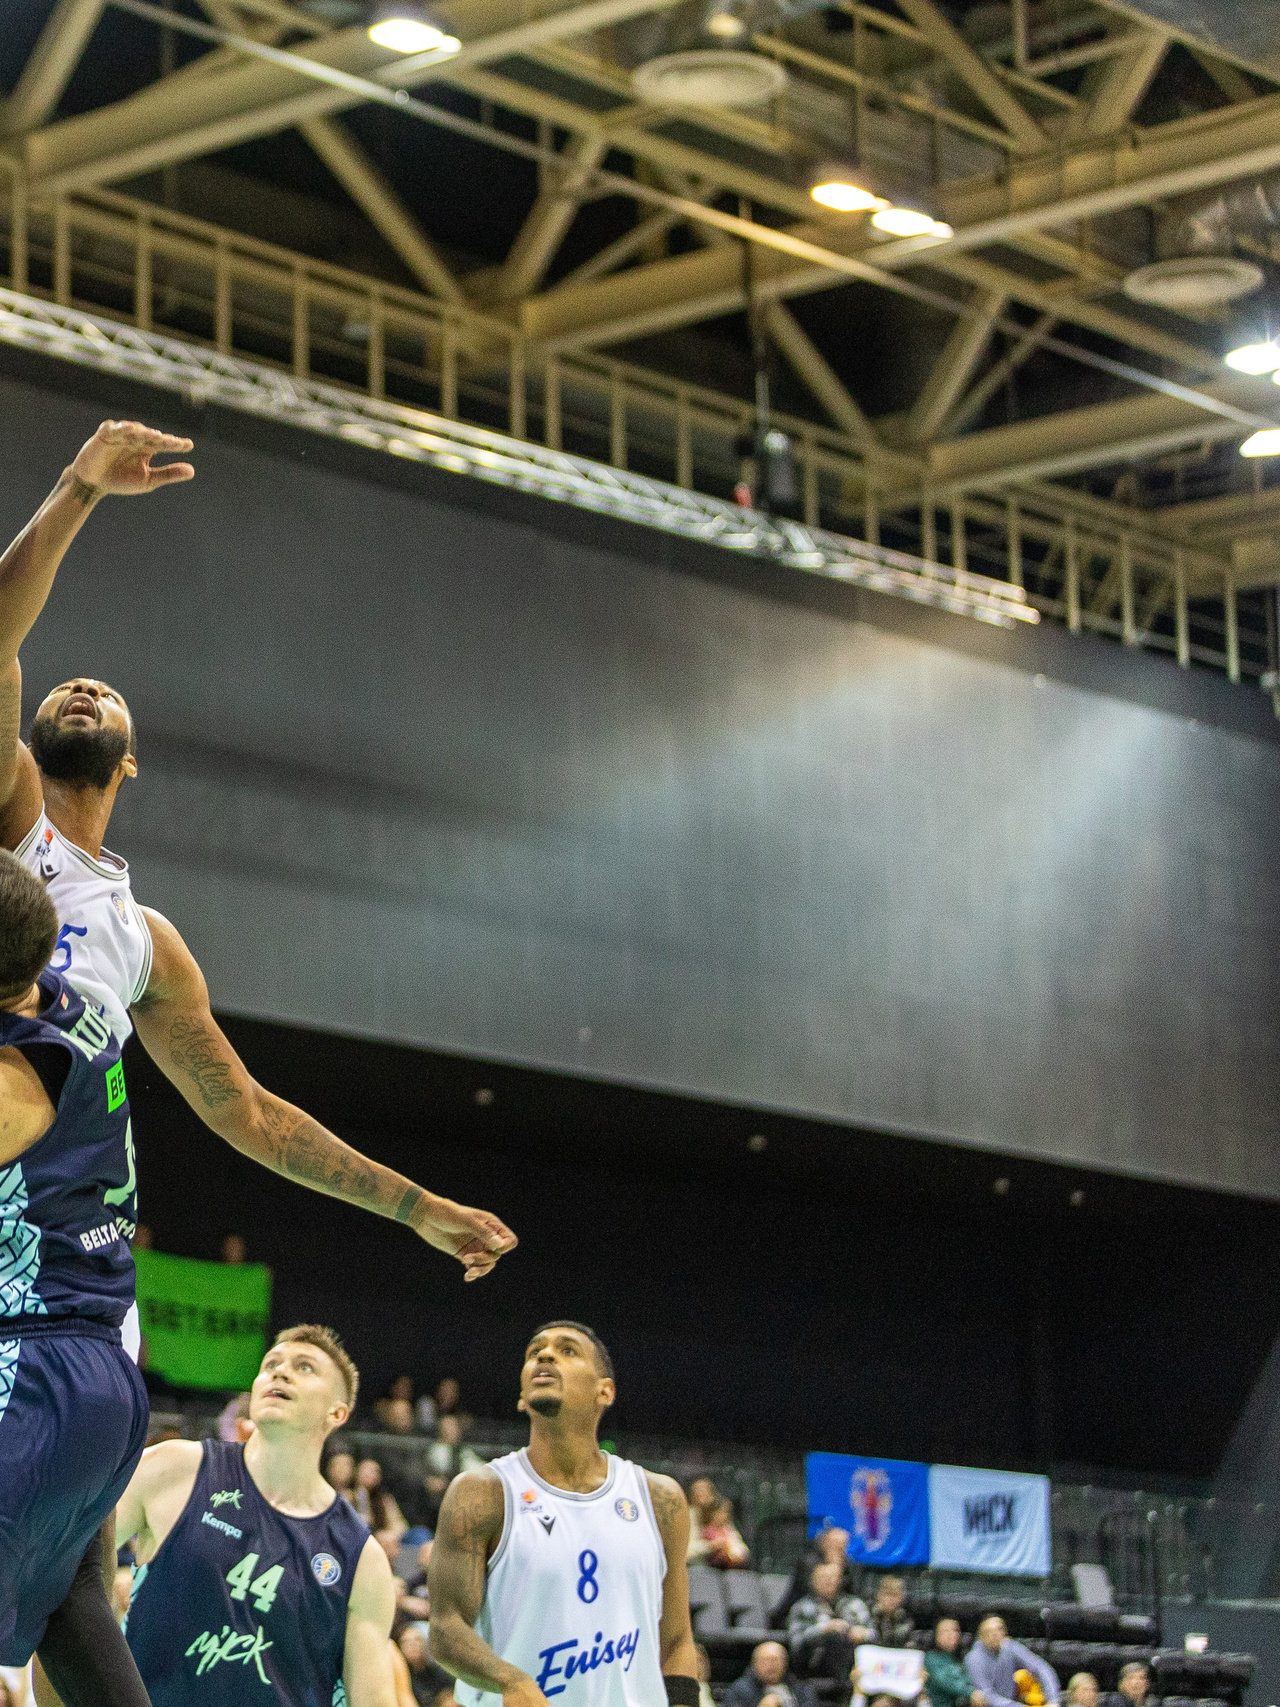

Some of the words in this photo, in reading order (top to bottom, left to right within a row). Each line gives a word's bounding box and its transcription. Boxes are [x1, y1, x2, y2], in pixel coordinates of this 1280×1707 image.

[201, 1511, 244, 1539] Kempa
[226, 1552, 286, 1614] 44
[577, 1549, 599, 1604] 8
[536, 1627, 639, 1698] Enisey
